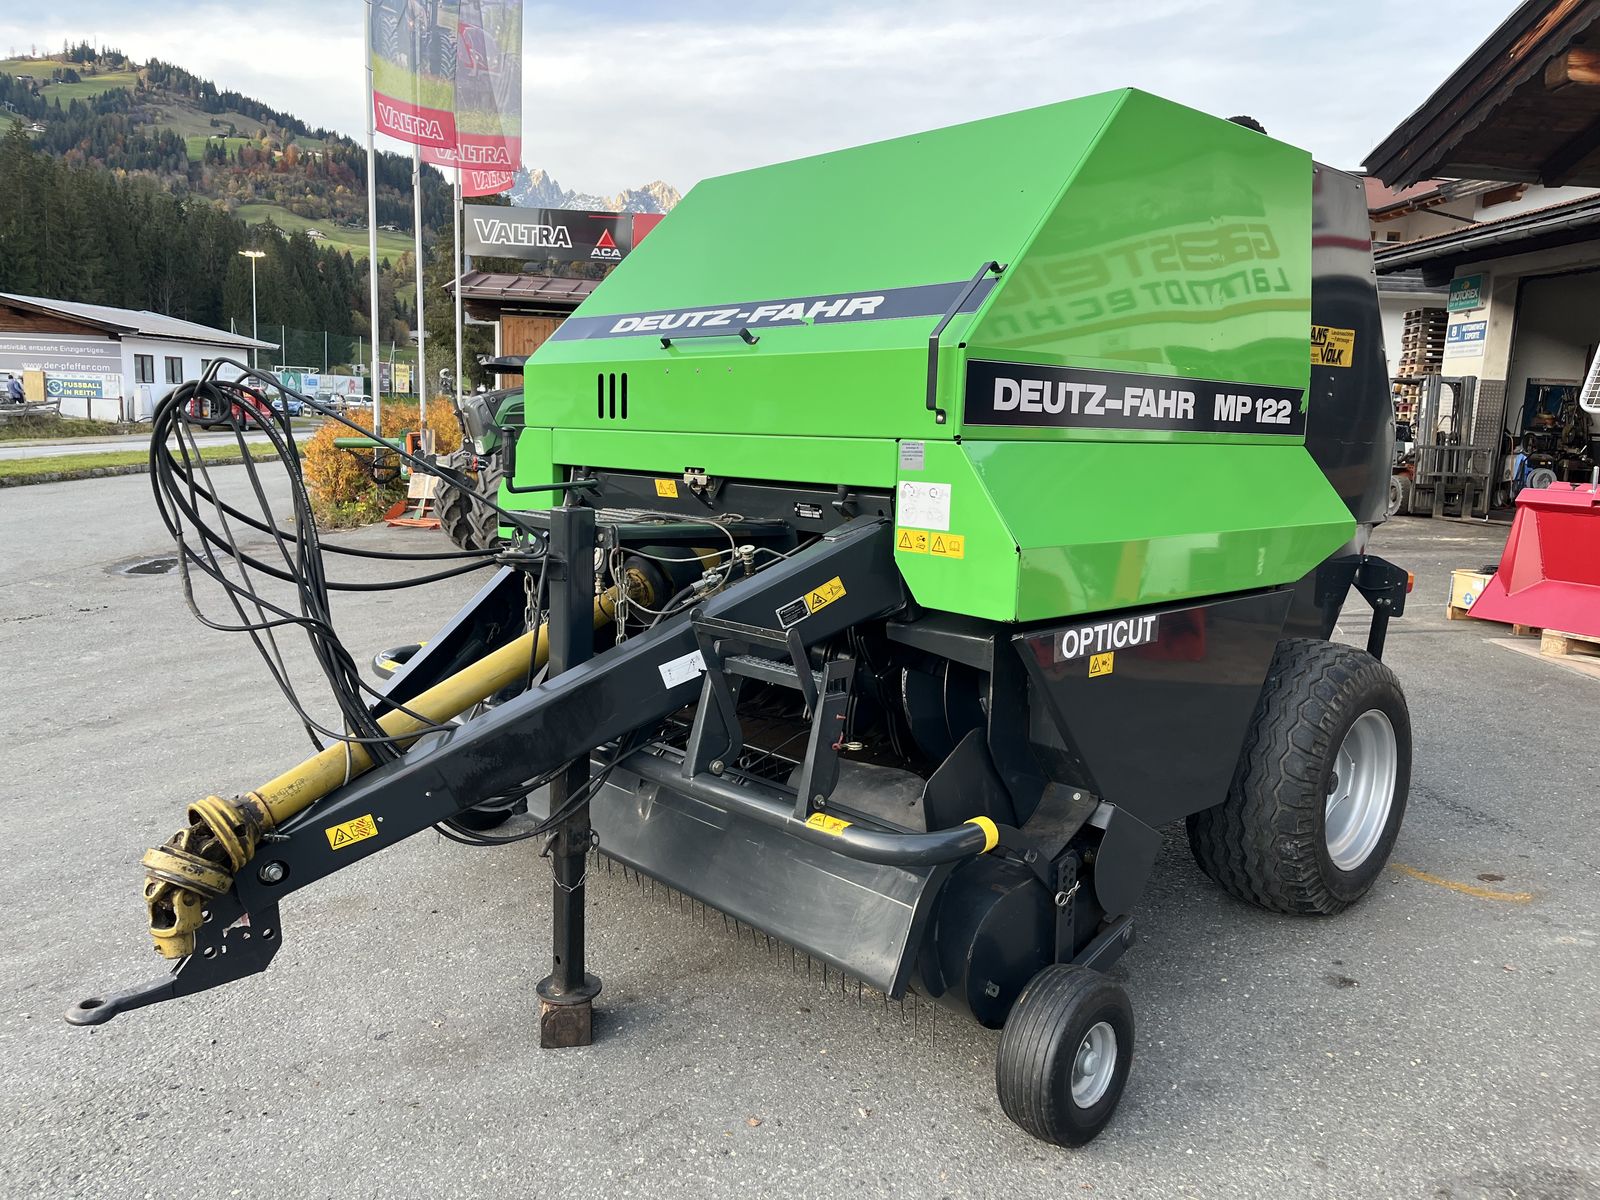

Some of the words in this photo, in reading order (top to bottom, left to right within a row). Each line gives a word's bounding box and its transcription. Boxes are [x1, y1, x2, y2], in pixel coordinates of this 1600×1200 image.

[378, 102, 444, 140] VALTRA
[435, 144, 512, 165] VALTRA
[473, 218, 573, 249] VALTRA
[591, 247, 622, 257] ACA
[609, 296, 885, 334] DEUTZ-FAHR
[63, 381, 101, 389] FUSSBALL
[993, 377, 1195, 419] DEUTZ-FAHR
[1062, 615, 1156, 659] OPTICUT
